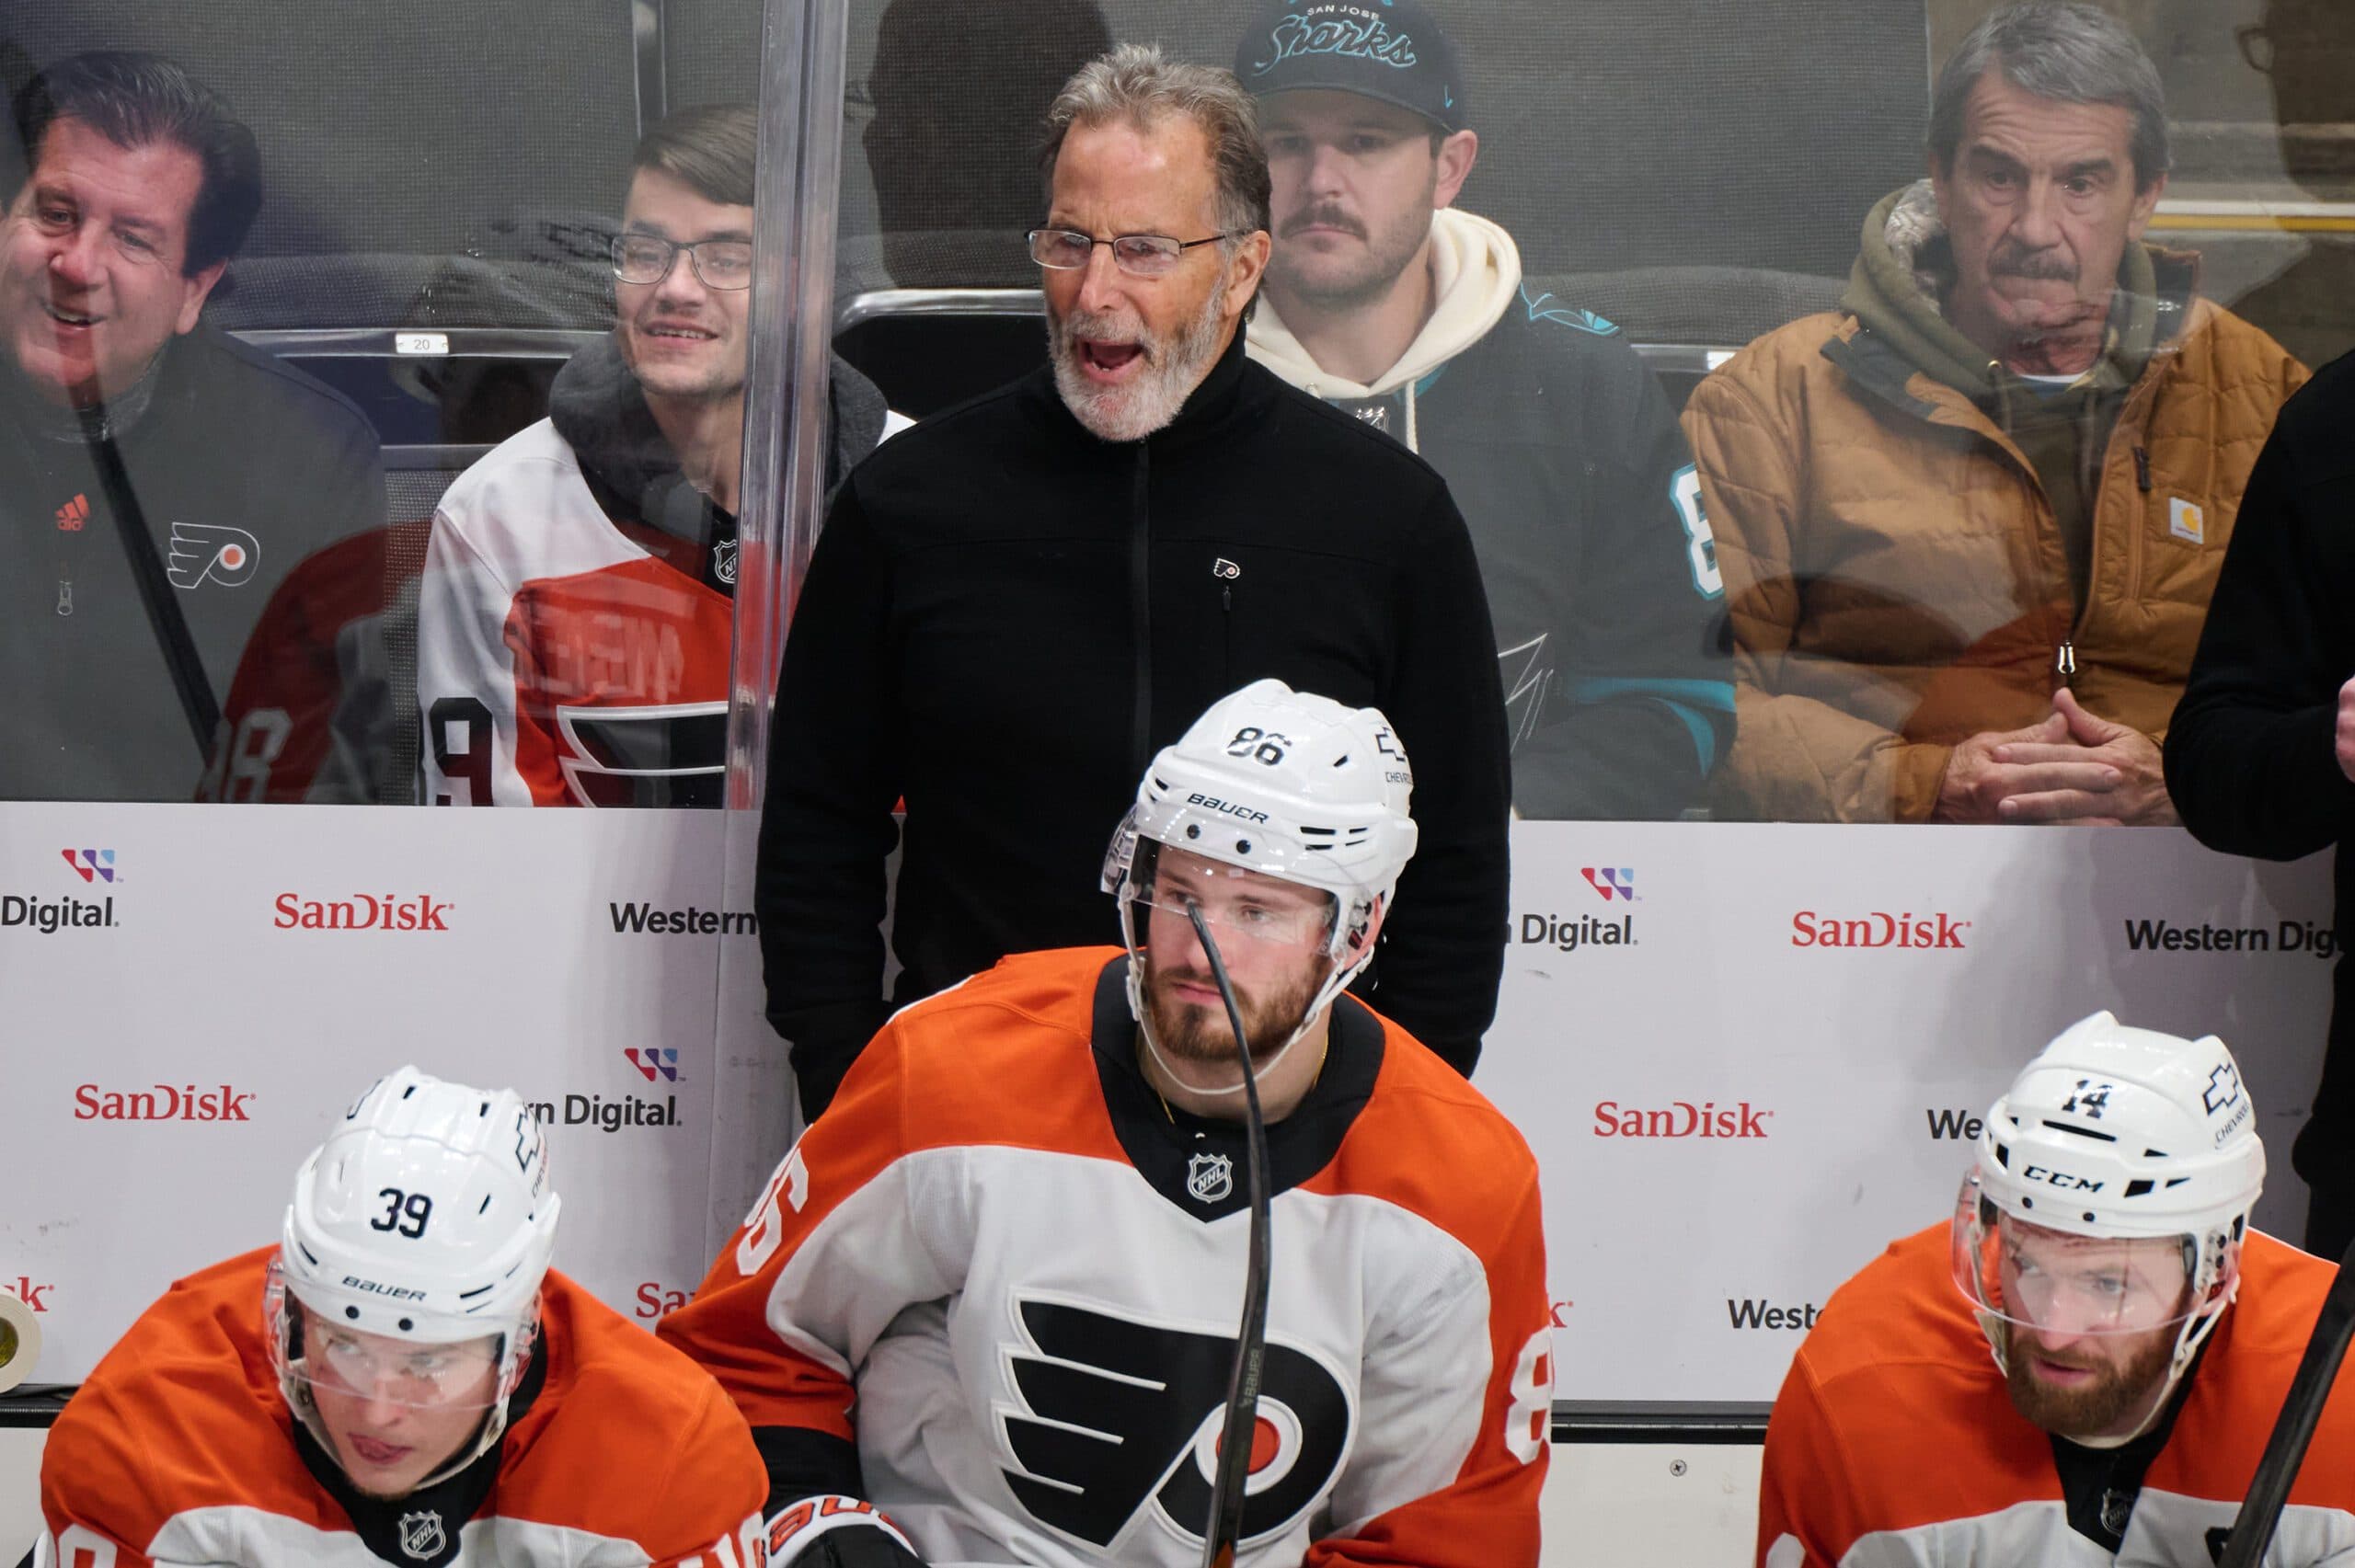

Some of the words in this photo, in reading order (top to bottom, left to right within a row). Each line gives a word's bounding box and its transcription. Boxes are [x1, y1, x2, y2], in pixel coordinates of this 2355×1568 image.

[1307, 5, 1335, 17] SAN
[1339, 5, 1379, 20] JOSE
[1252, 15, 1417, 77] Sharks
[413, 338, 431, 350] 20
[1226, 727, 1292, 766] 86
[1, 896, 113, 934] Digital
[274, 893, 449, 931] SanDisk
[610, 902, 757, 935] Western
[1792, 911, 1966, 948] SanDisk
[1522, 913, 1632, 953] Digital
[2125, 920, 2269, 951] Western
[2279, 921, 2342, 959] Dig
[75, 1084, 250, 1121] SanDisk
[565, 1094, 676, 1133] Digital
[2062, 1080, 2113, 1119] 14
[1594, 1102, 1768, 1138] SanDisk
[1926, 1109, 1984, 1140] We
[1198, 1166, 1224, 1193] NHL
[2024, 1165, 2105, 1194] CCM
[370, 1187, 433, 1240] 39
[637, 1282, 696, 1318] Sa
[410, 1522, 436, 1550] NHL
